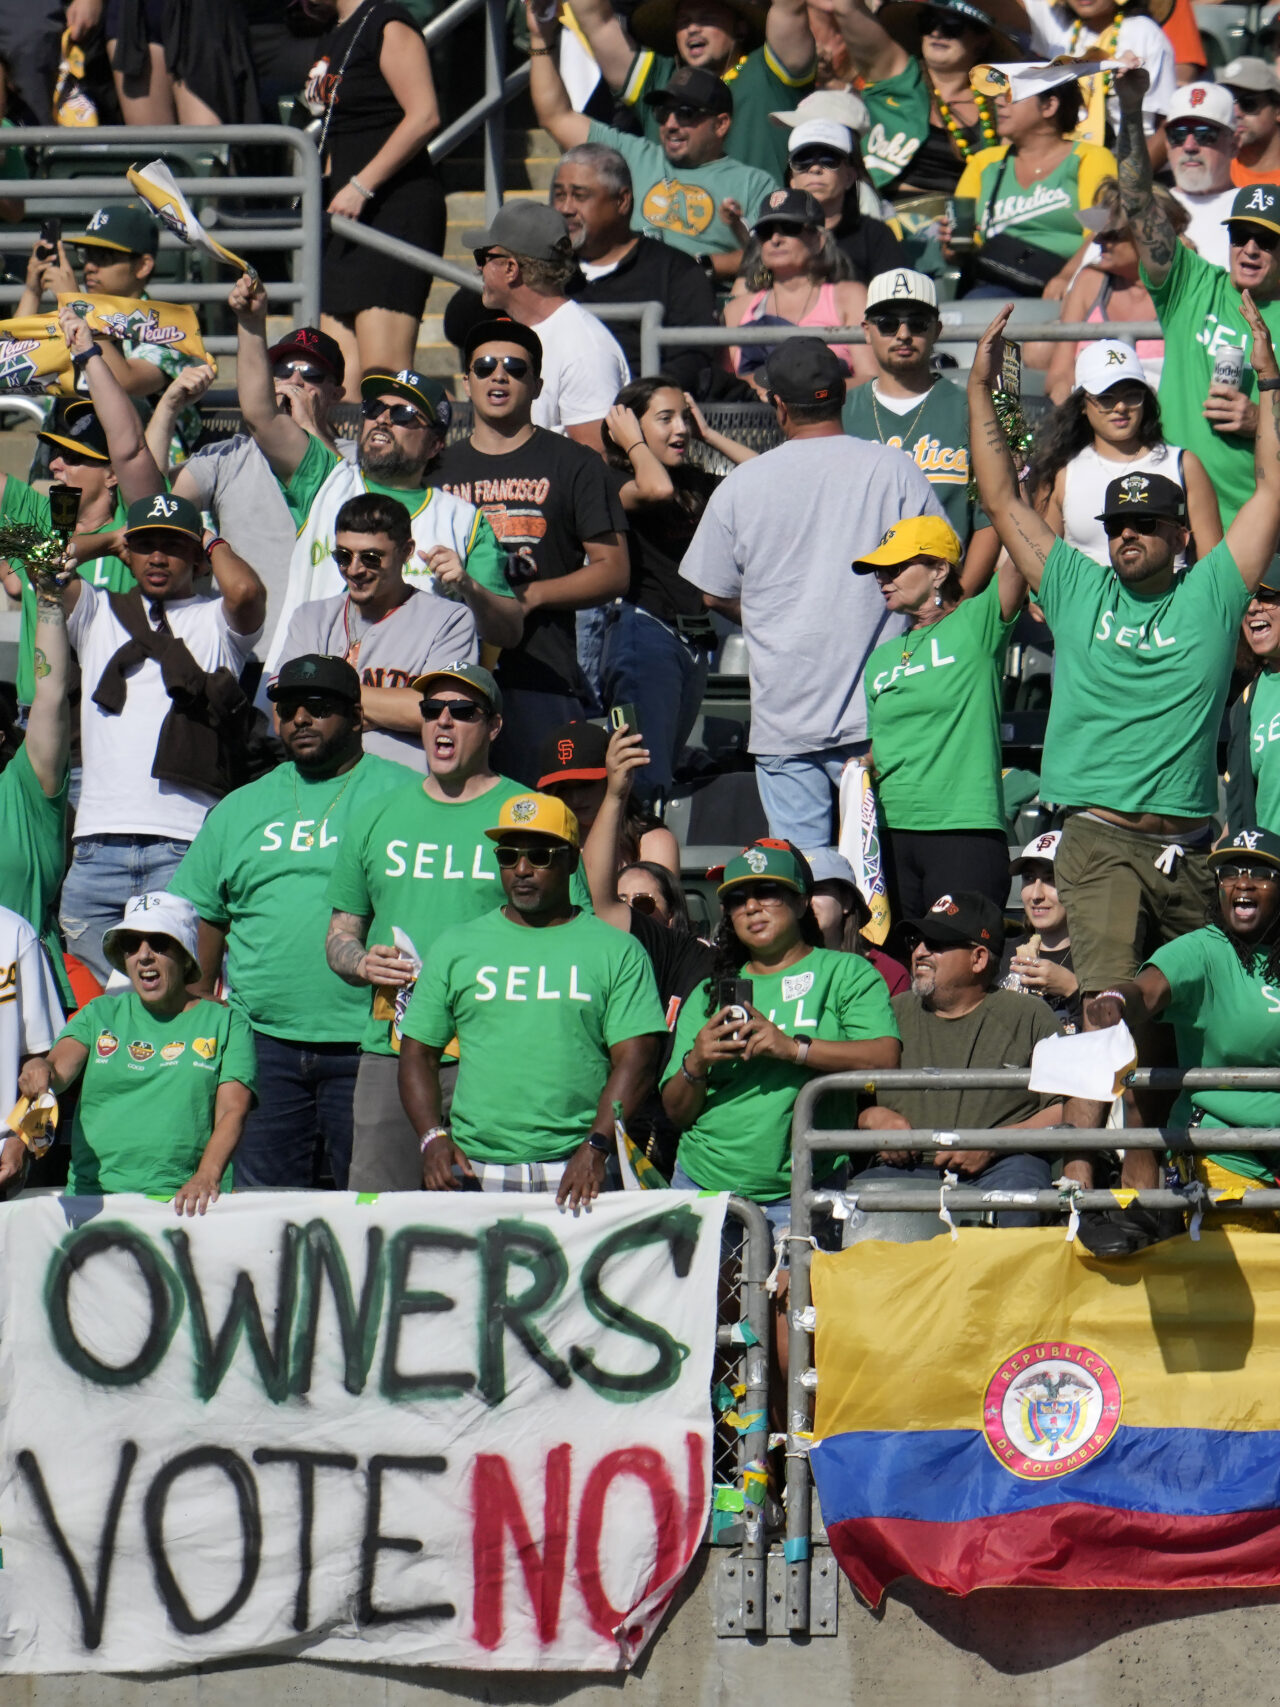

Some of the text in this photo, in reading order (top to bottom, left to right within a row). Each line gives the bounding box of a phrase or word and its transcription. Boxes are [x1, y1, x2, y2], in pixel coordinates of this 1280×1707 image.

[1245, 188, 1274, 211] A's
[86, 208, 110, 231] A's
[892, 273, 913, 297] A
[134, 320, 186, 345] Team
[295, 329, 319, 348] A's
[396, 370, 418, 386] A's
[475, 477, 550, 504] FRANCISCO
[147, 495, 178, 518] A's
[1096, 610, 1176, 650] SELL
[558, 739, 575, 765] SF
[386, 839, 495, 880] SELL
[132, 894, 160, 912] A's
[475, 966, 592, 1002] SELL
[44, 1204, 702, 1404] OWNERS
[1001, 1346, 1104, 1382] REPUBLICA
[996, 1434, 1105, 1473] DE COLOMBIA
[16, 1439, 456, 1650] VOTE
